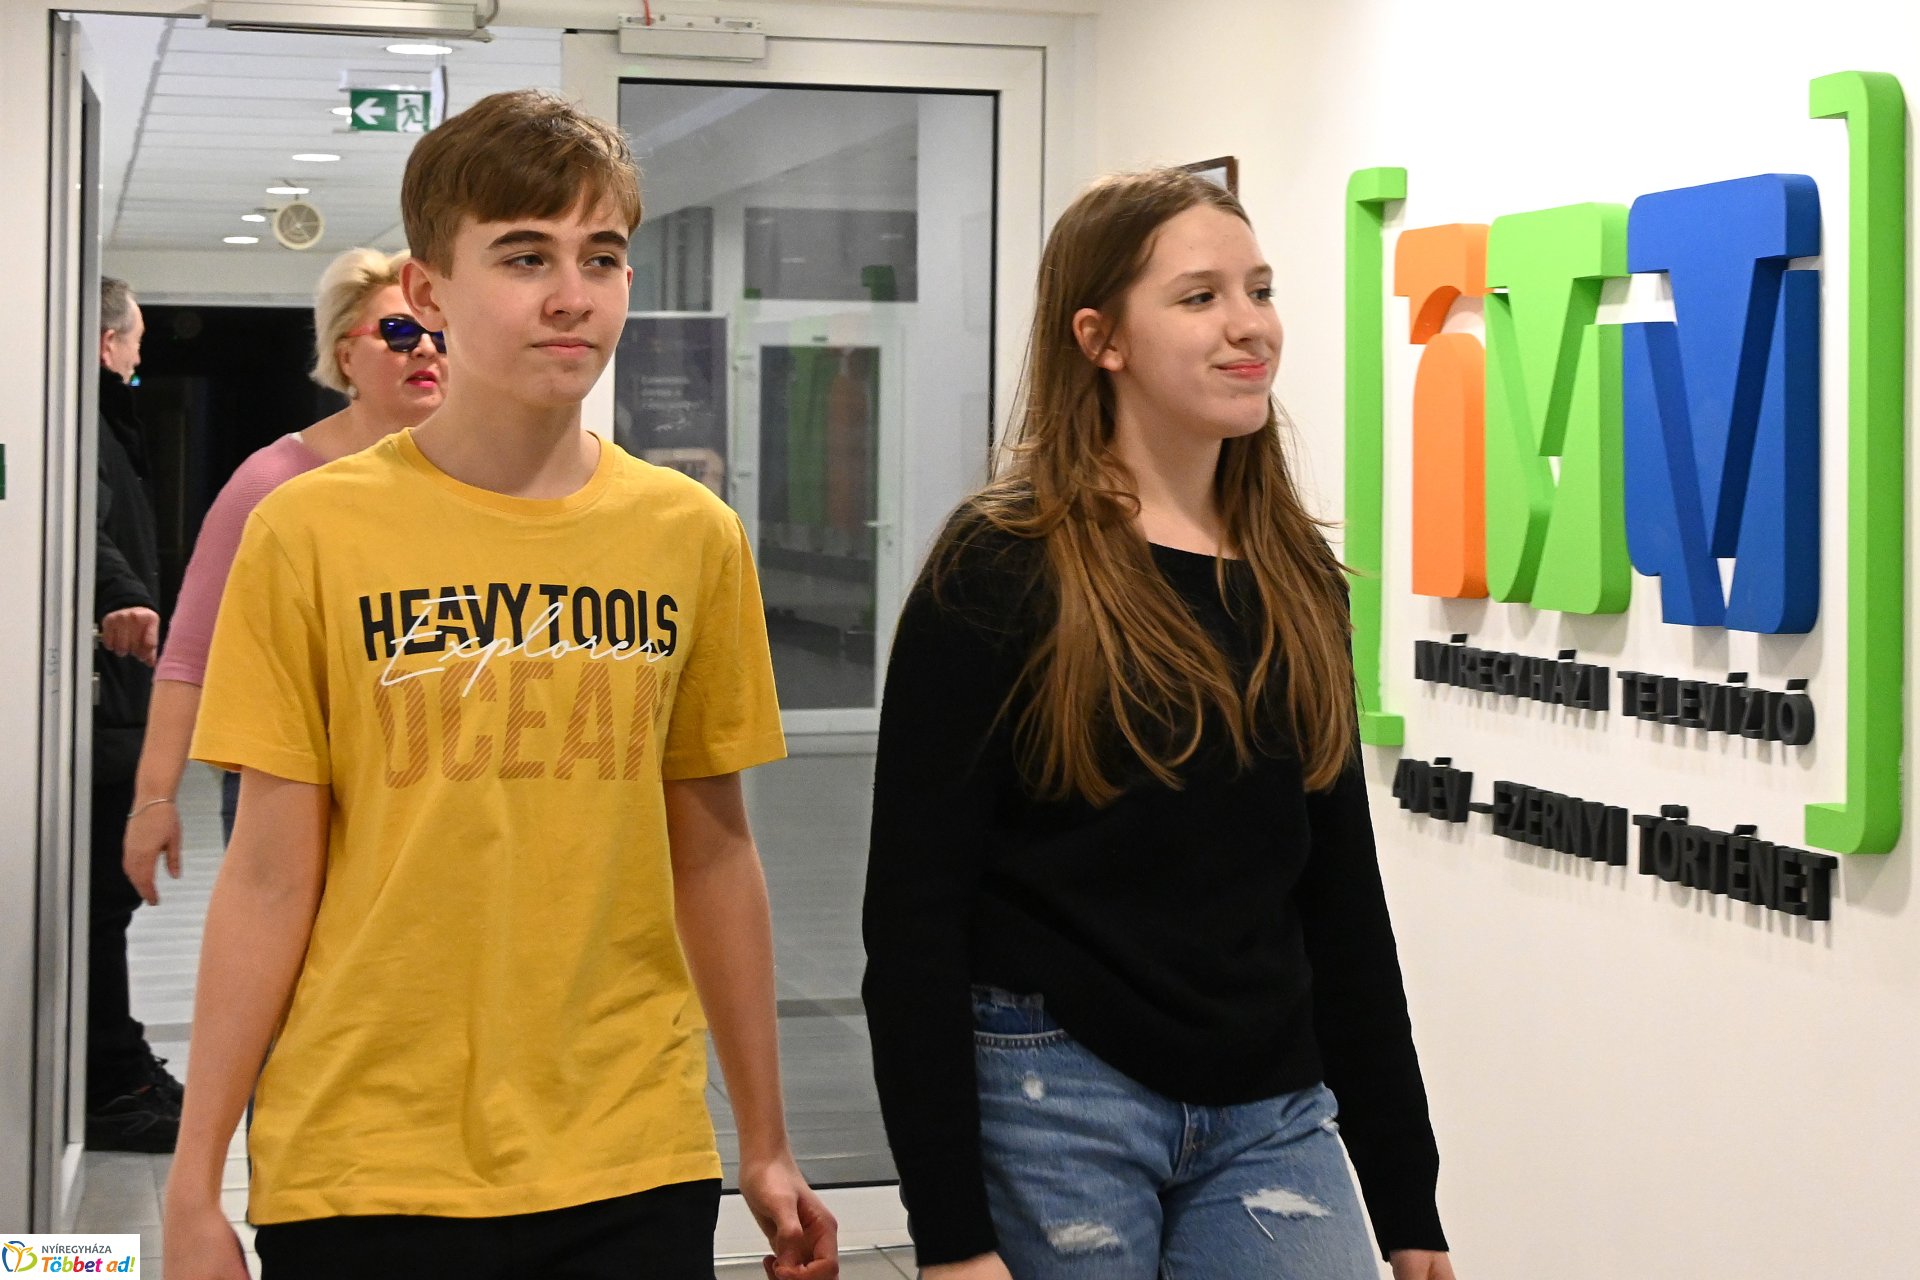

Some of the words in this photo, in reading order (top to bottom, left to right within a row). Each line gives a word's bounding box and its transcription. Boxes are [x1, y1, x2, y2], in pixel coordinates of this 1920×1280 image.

[359, 583, 531, 661] HEAVY
[539, 584, 678, 657] TOOLS
[381, 595, 669, 698] Explorer
[1414, 633, 1610, 711] NYÍREGYHÁZI
[1617, 672, 1816, 745] TELEVÍZIÓ
[1493, 781, 1628, 866] EZERNYI
[1633, 804, 1838, 921] TÖRTÉNET
